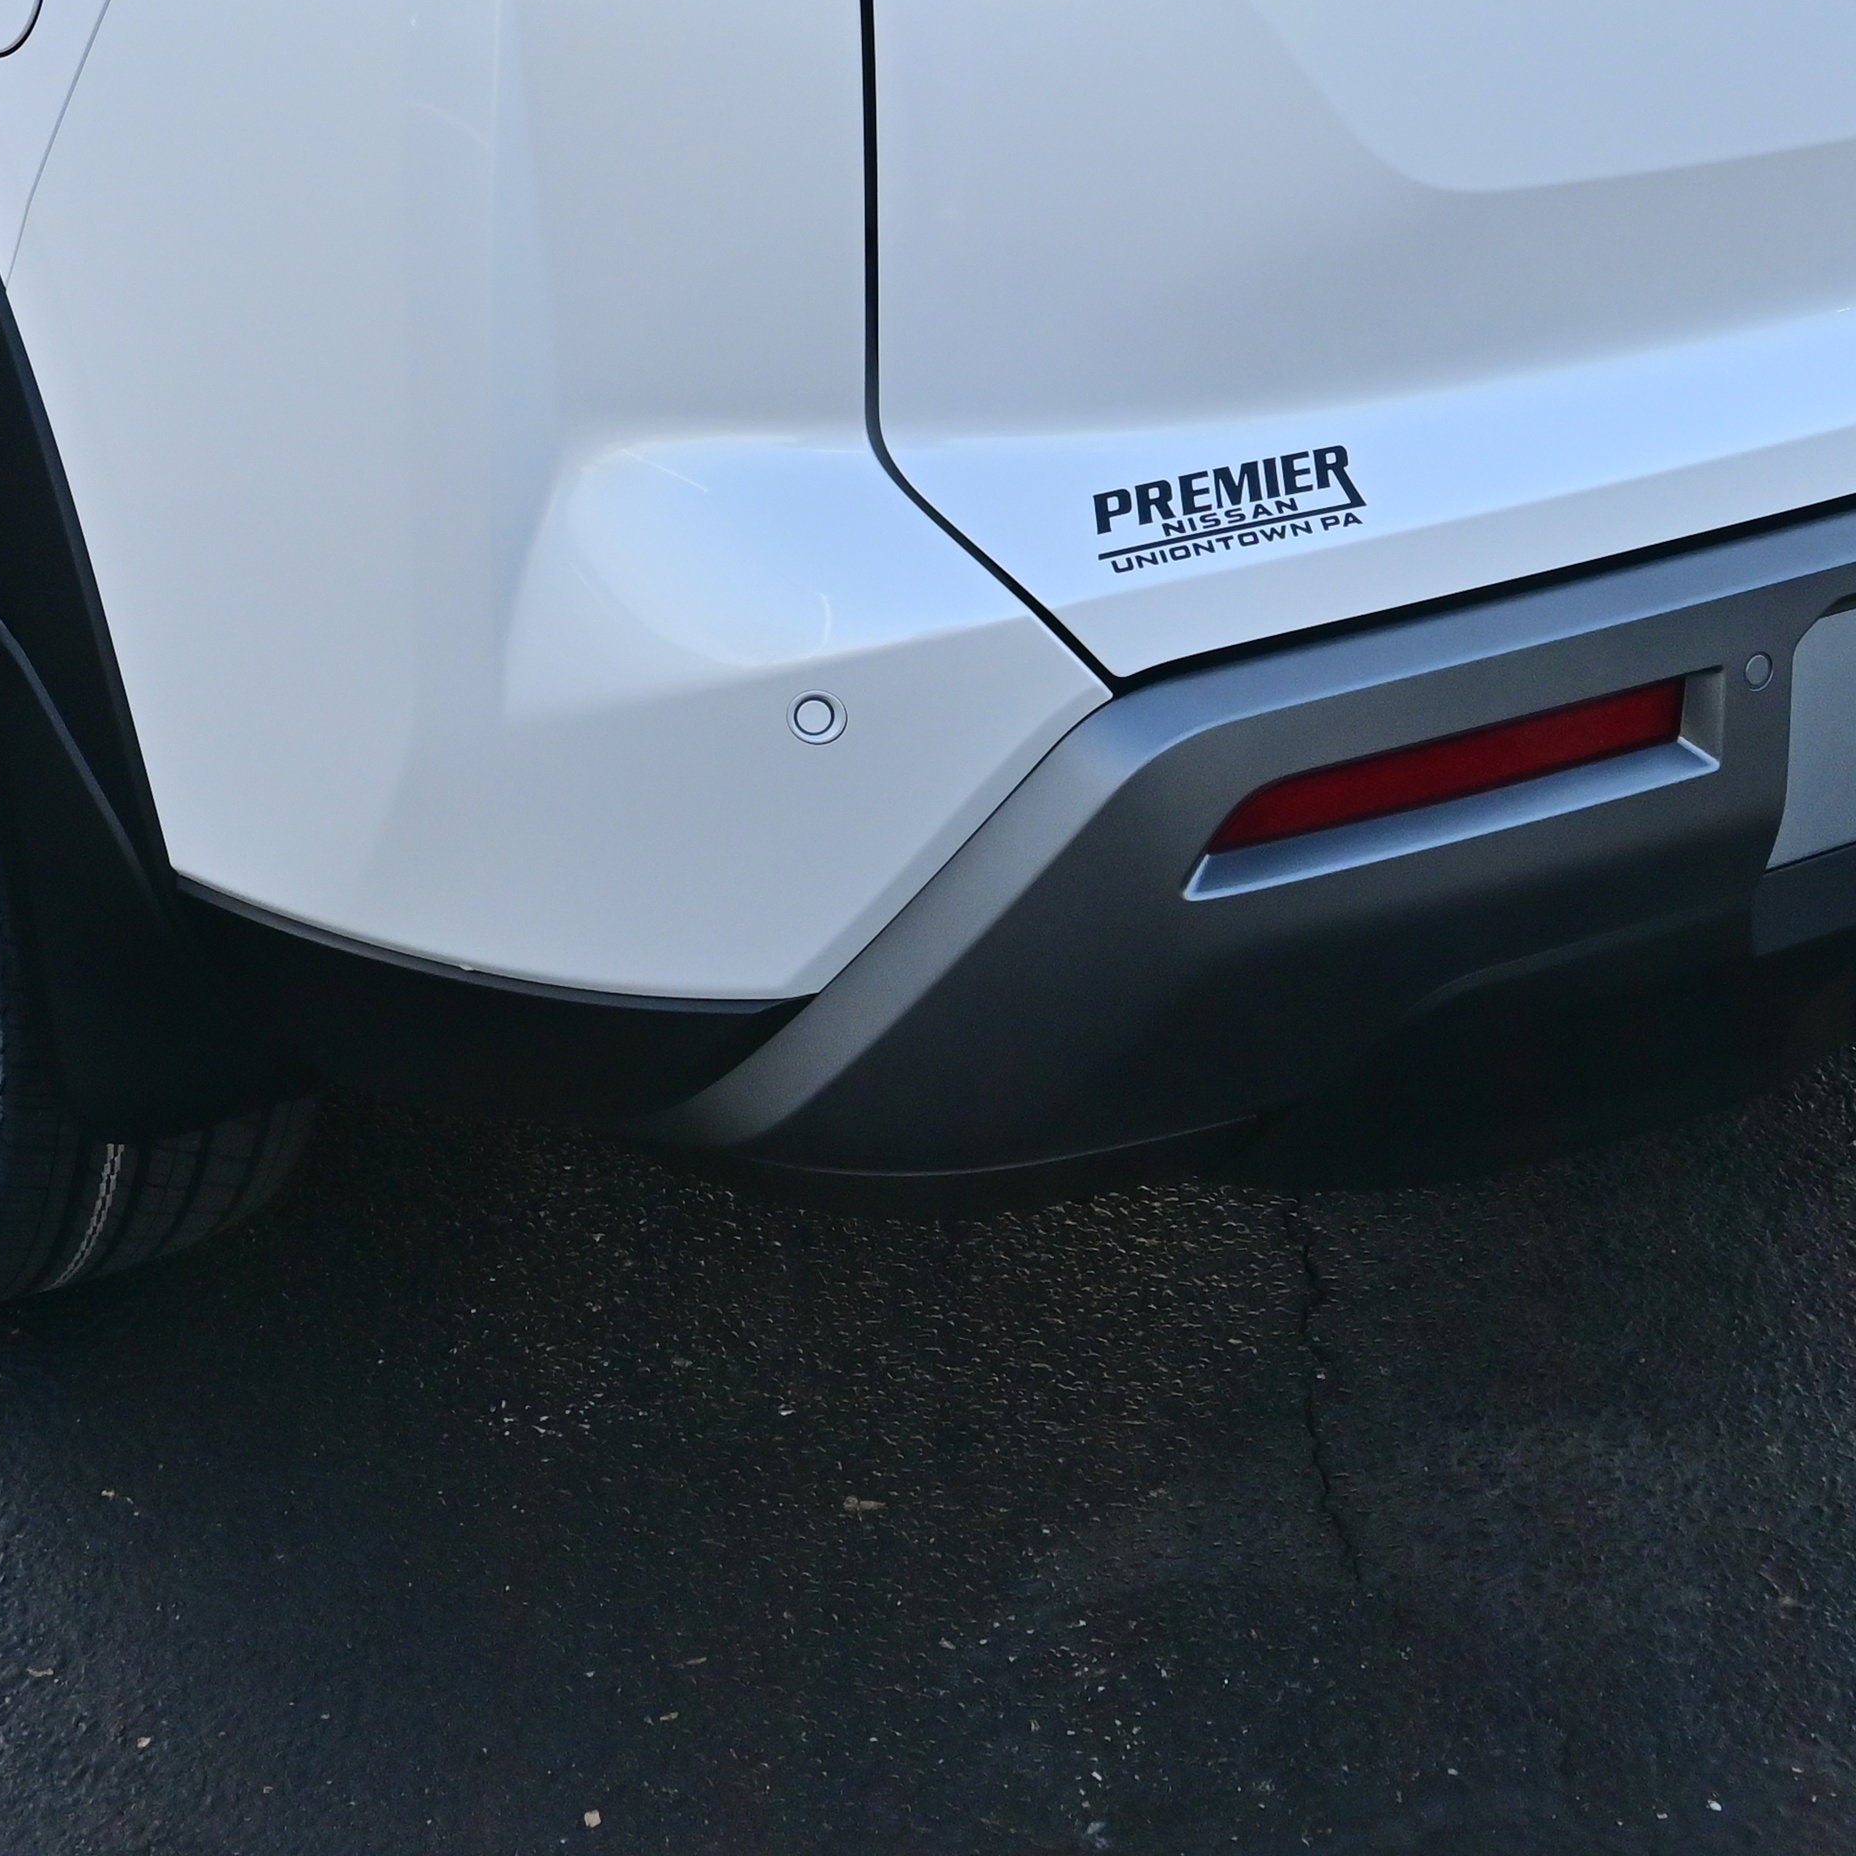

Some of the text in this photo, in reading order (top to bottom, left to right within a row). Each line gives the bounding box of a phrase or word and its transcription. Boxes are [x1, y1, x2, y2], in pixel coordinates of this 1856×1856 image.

[1092, 444, 1366, 535] PREMIER
[1163, 497, 1299, 537] NISSAN
[1111, 511, 1363, 574] UNIONTOWN PA
